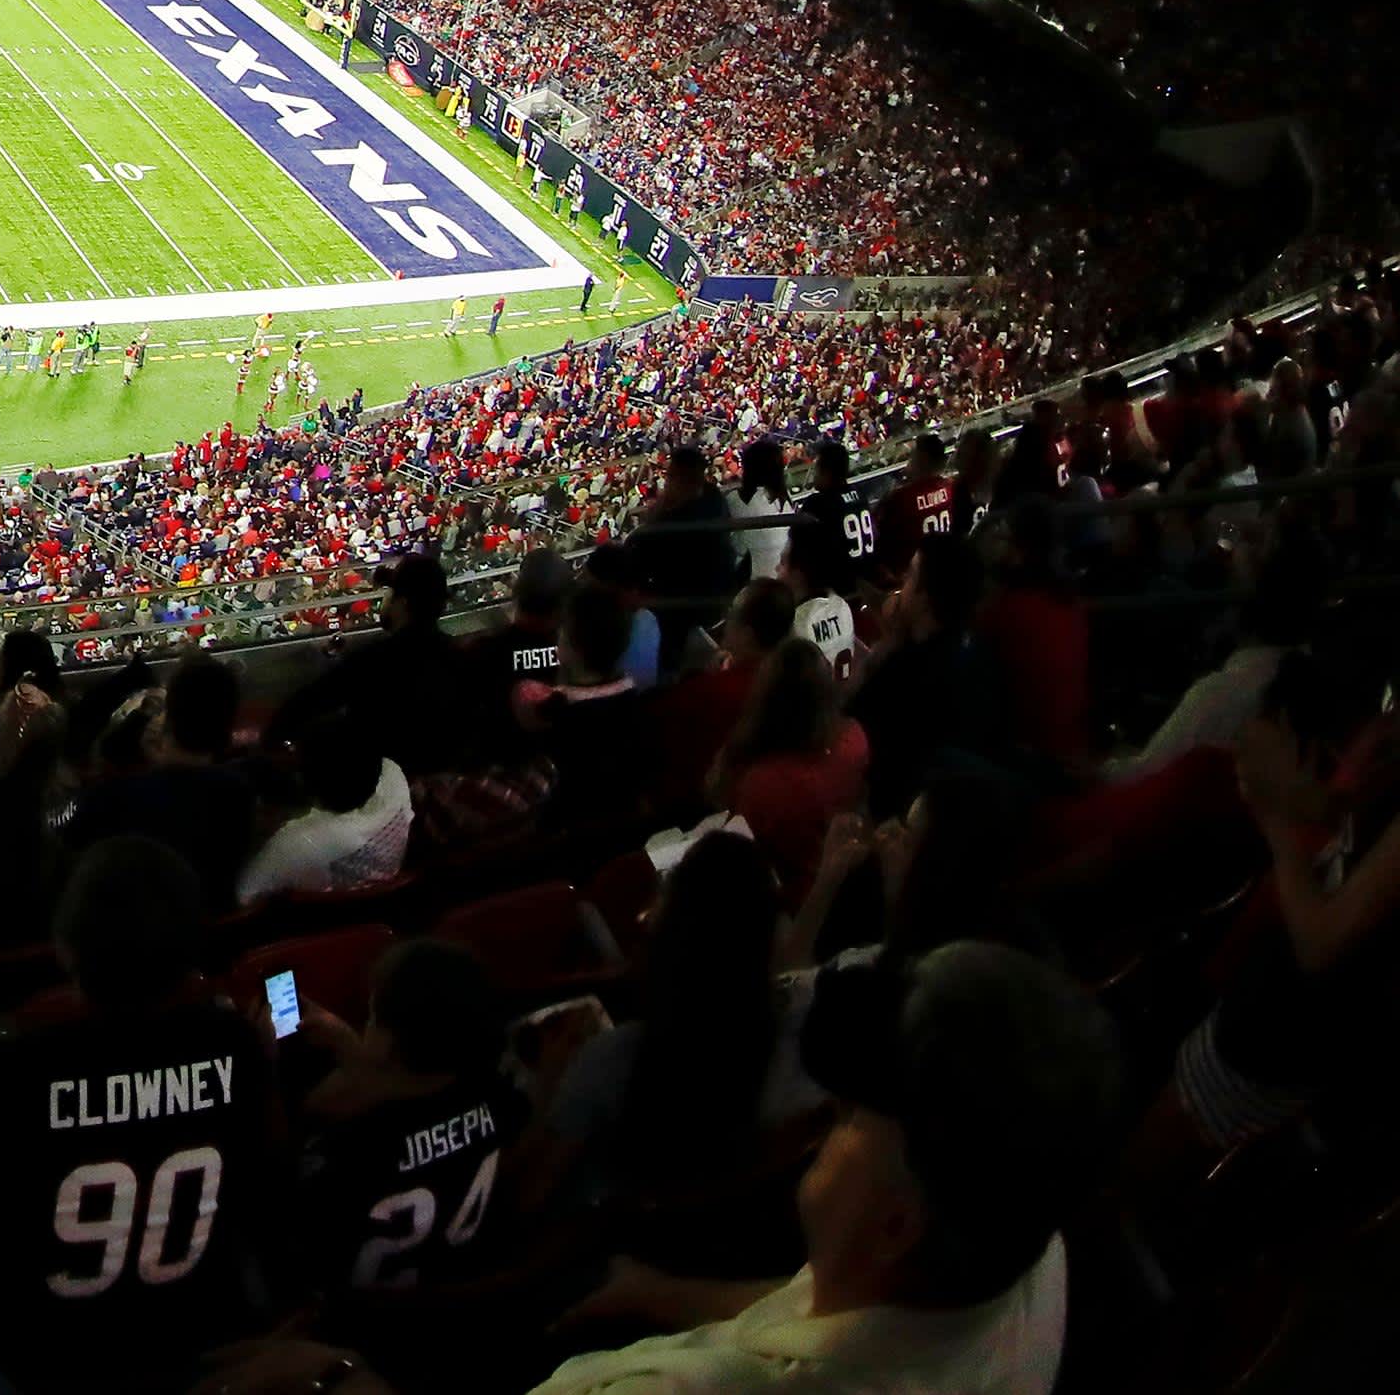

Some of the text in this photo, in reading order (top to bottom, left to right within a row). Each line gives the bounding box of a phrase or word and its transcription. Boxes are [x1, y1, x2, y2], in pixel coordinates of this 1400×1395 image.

[79, 162, 146, 184] 10
[650, 236, 668, 262] 27
[842, 509, 875, 558] 99
[812, 615, 841, 643] WATT
[512, 644, 561, 672] FOSTE
[49, 1055, 233, 1130] CLOWNEY
[398, 1100, 496, 1173] JOSEPH
[45, 1145, 224, 1299] 90
[351, 1147, 499, 1290] 24
